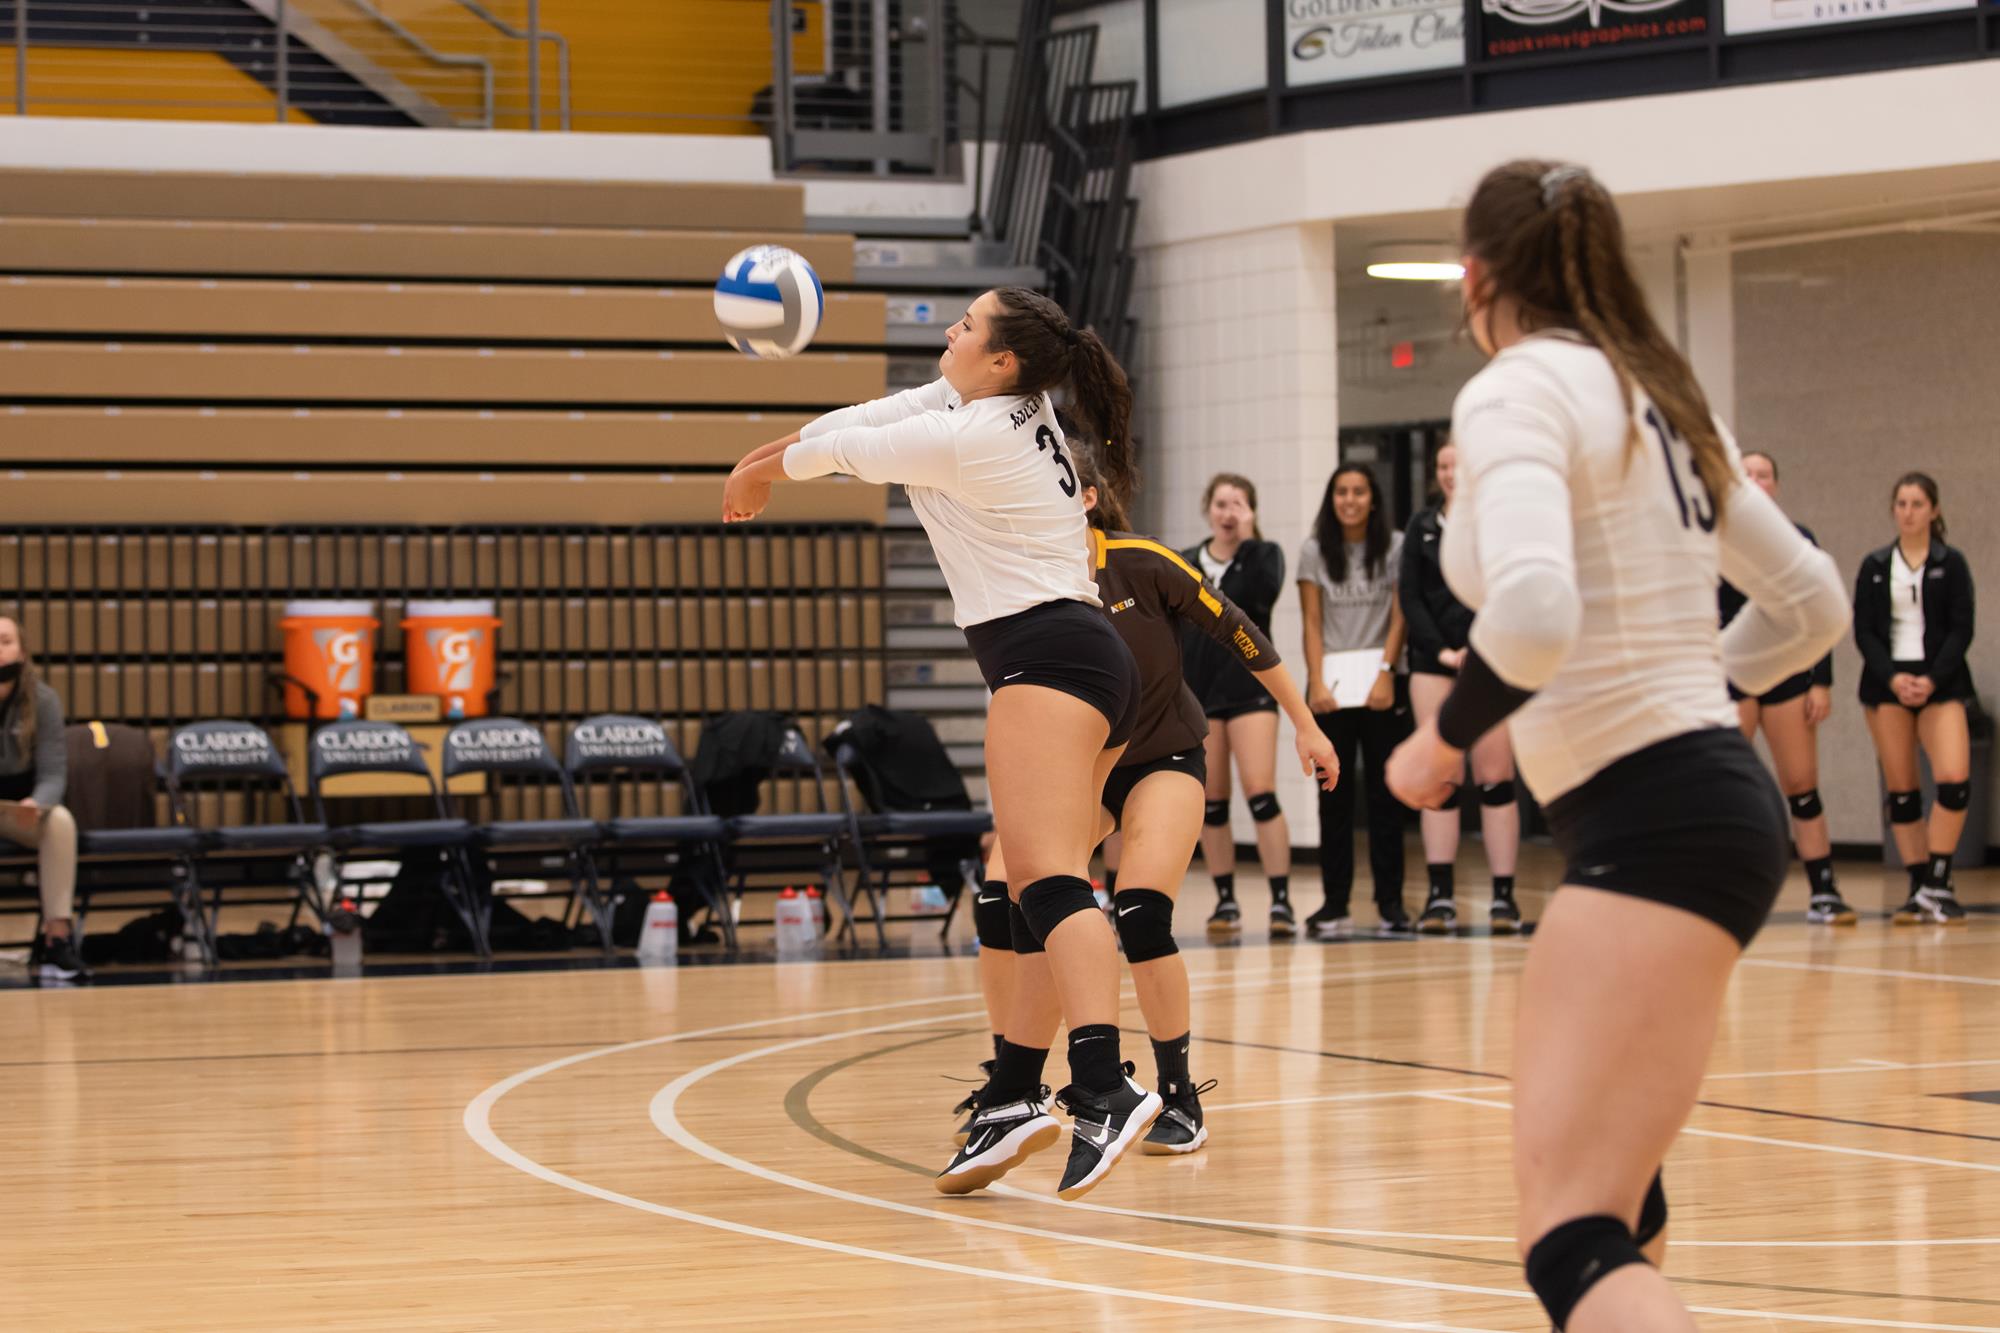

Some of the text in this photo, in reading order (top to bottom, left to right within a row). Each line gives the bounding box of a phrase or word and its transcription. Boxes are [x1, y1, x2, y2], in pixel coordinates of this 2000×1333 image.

[1813, 0, 1888, 18] DINING
[1488, 17, 1706, 56] clarkvinylgraphics.com
[1036, 424, 1076, 498] 3
[1911, 583, 1918, 604] 1
[331, 632, 360, 664] G
[442, 632, 470, 663] G
[176, 730, 269, 751] CLARION
[316, 729, 410, 750] CLARION
[449, 728, 541, 748] CLARION
[574, 725, 665, 743] CLARION
[181, 751, 271, 765] UNIVERSITY
[323, 750, 411, 763] UNIVERSITY
[455, 748, 542, 762] UNIVERSITY
[579, 743, 666, 757] UNIVERSITY
